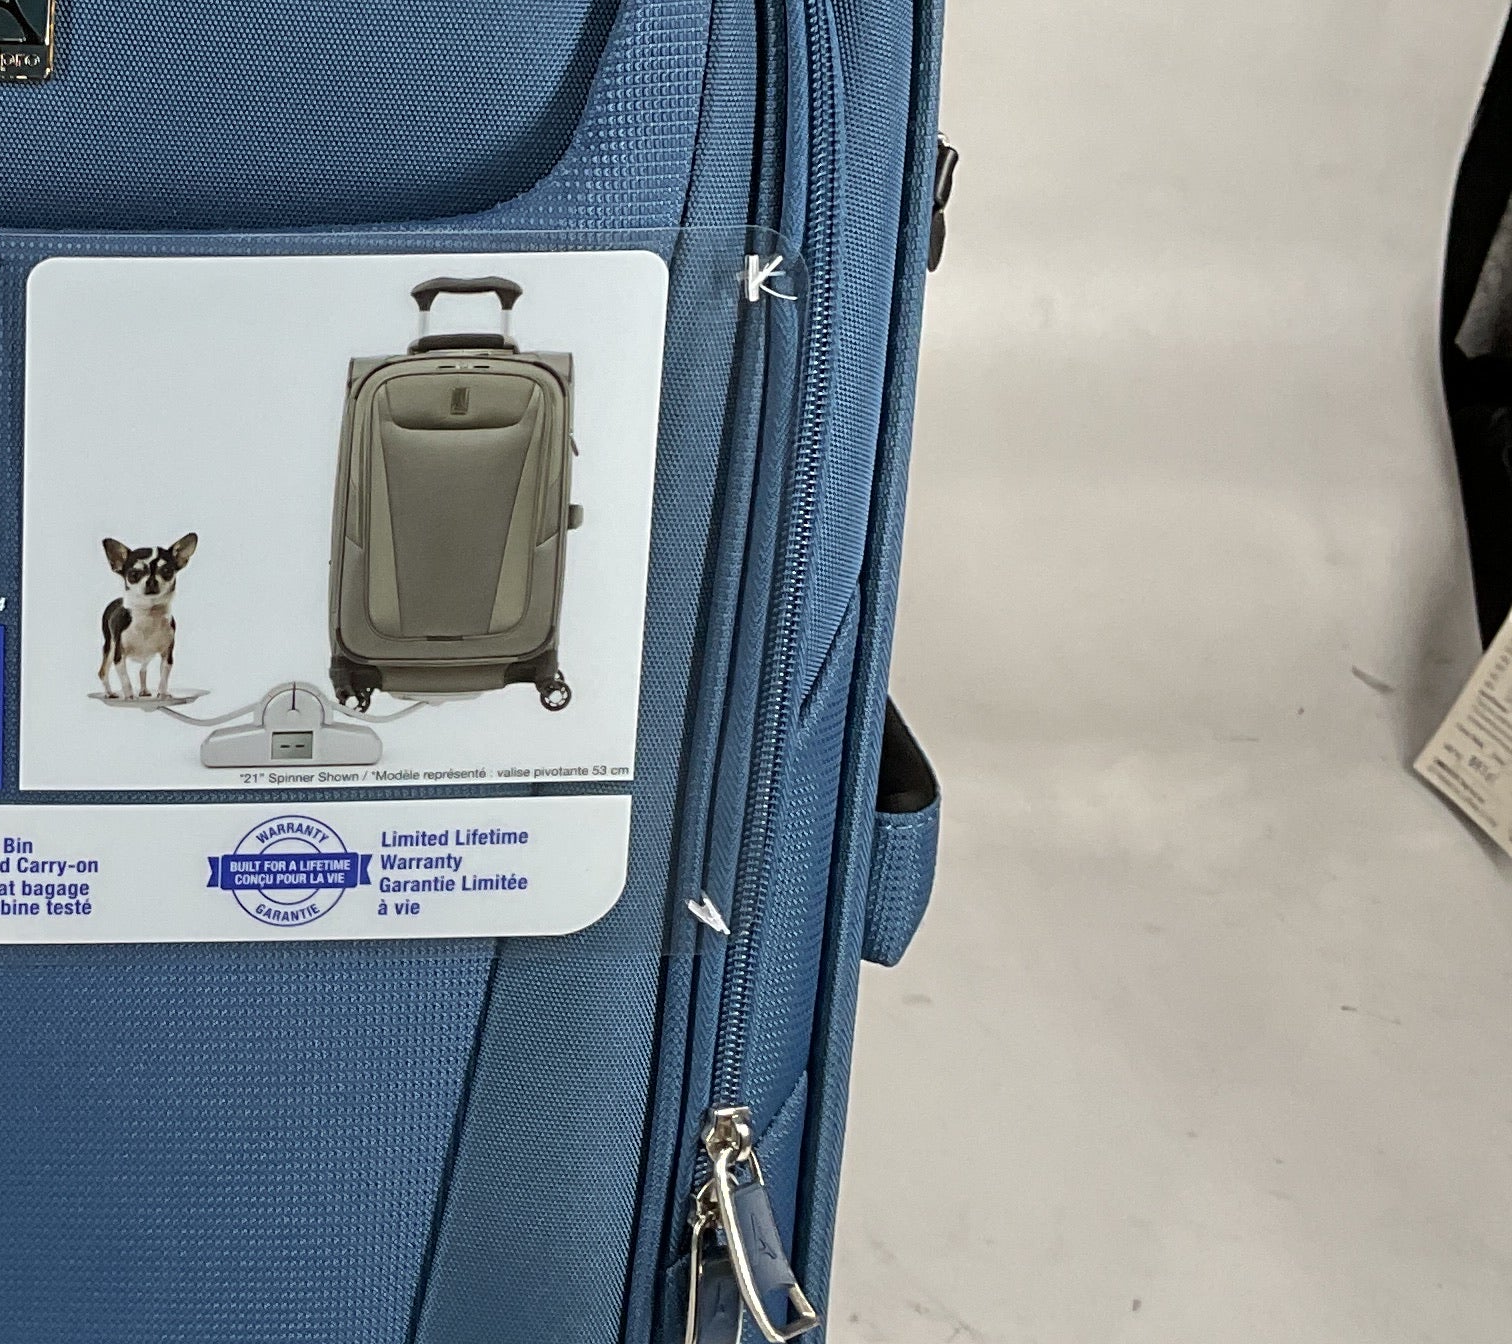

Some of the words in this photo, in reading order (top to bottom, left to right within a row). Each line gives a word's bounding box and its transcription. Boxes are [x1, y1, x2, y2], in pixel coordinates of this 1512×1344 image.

[268, 772, 315, 786] Spinner
[322, 771, 360, 783] Shown
[361, 770, 368, 782] /
[423, 766, 487, 781] représenté
[496, 766, 530, 778] valise
[534, 765, 589, 780] pivotante
[591, 765, 607, 776] 53
[610, 766, 630, 776] cm
[255, 822, 330, 844] WARRANTY
[381, 830, 449, 847] Limited
[455, 828, 529, 846] Lifetime
[3, 837, 33, 854] Bin
[17, 857, 99, 877] Carry-on
[230, 861, 261, 872] BUILT
[264, 860, 286, 872] FOR
[289, 860, 297, 871] A
[300, 859, 351, 871] LIFETIME
[380, 853, 463, 874] Warranty
[21, 880, 90, 899] bagage
[234, 874, 274, 888] CONÇU
[276, 873, 307, 884] POUR
[310, 873, 325, 884] LA
[327, 872, 345, 884] VIE
[379, 875, 455, 893] Garantie
[461, 873, 528, 891] Limitée
[46, 898, 92, 915] testé
[255, 903, 321, 922] GARANTIE
[377, 899, 388, 916] à
[394, 899, 421, 916] vie
